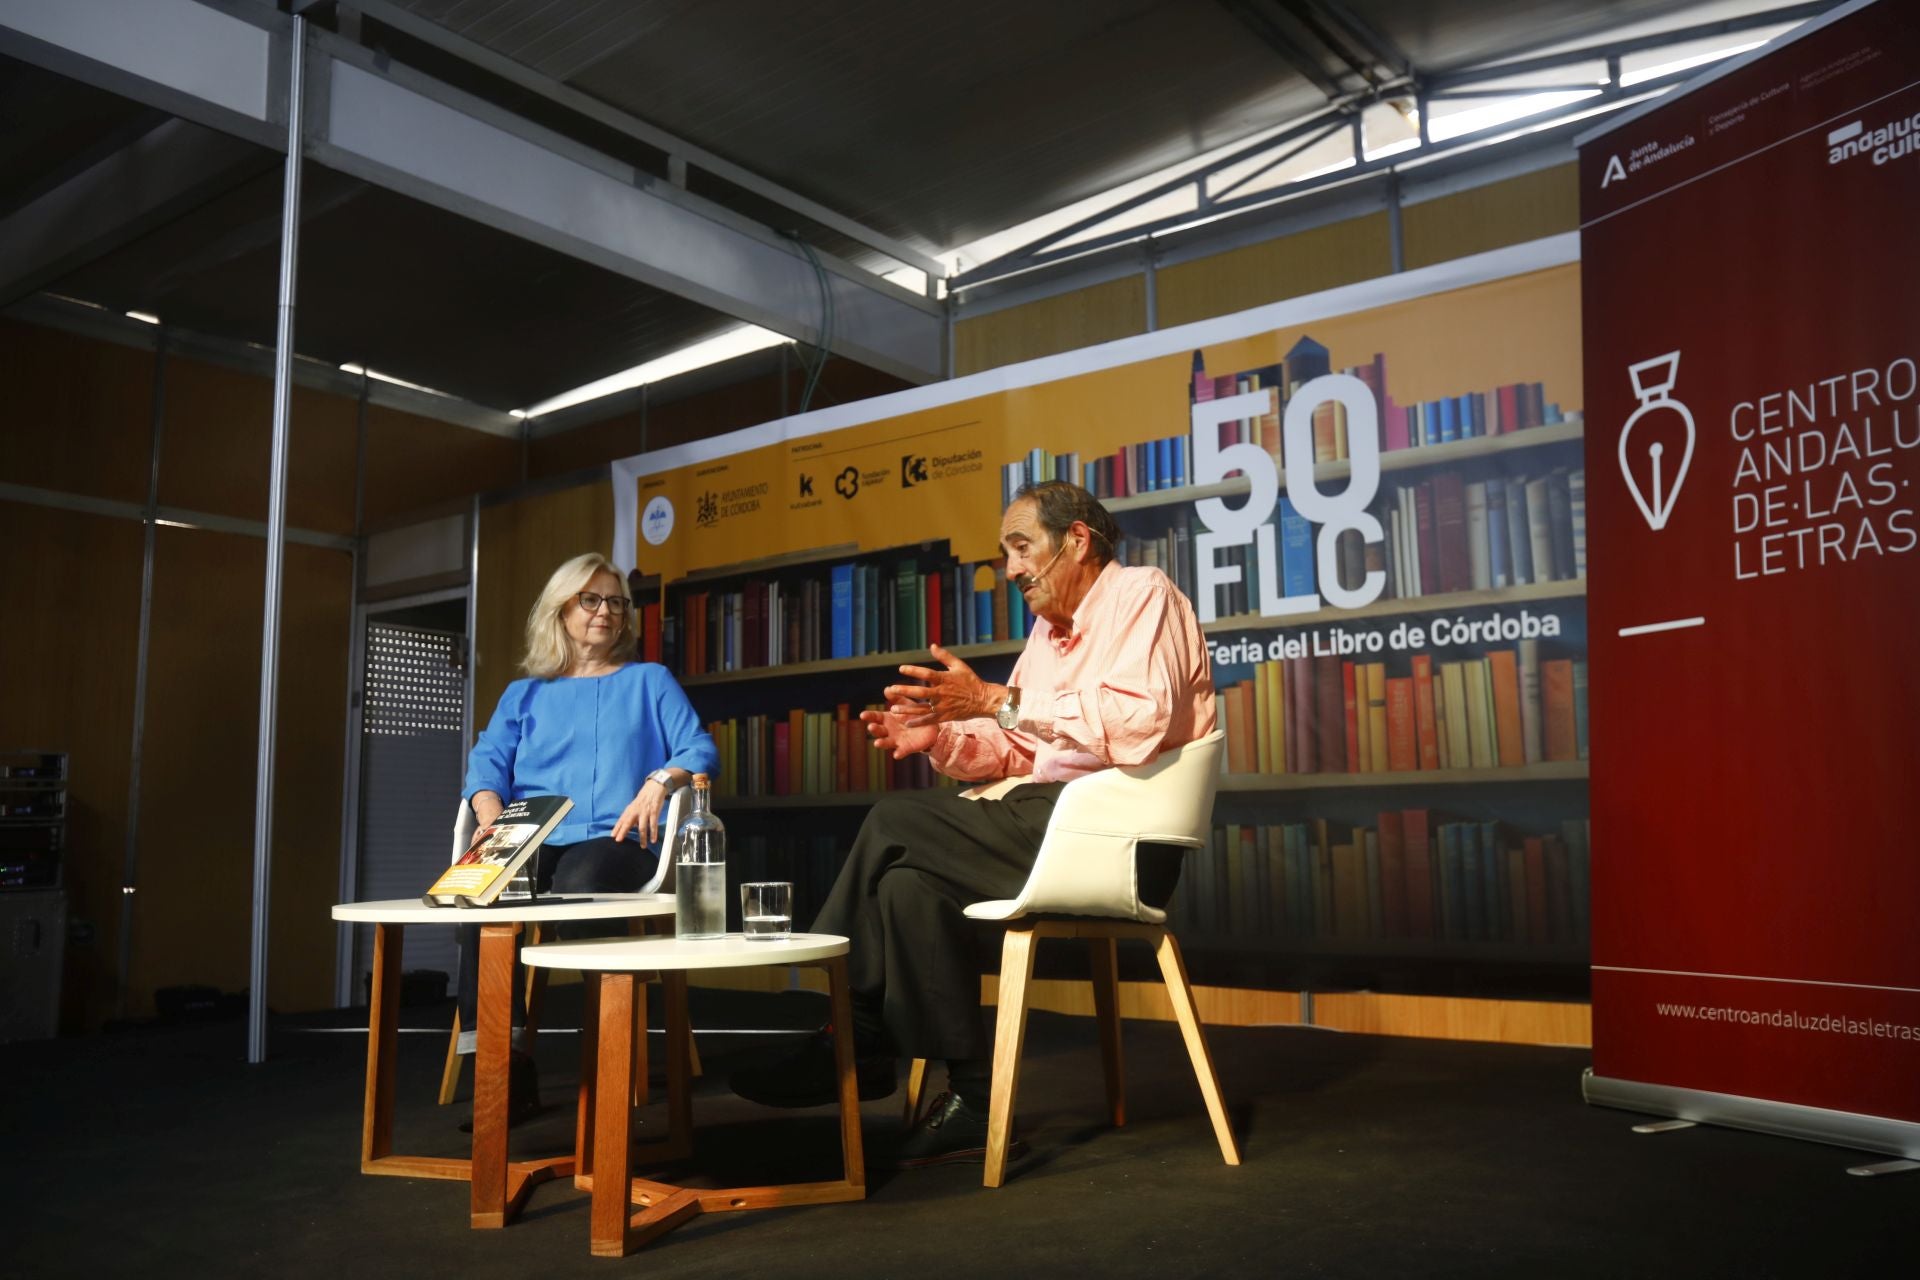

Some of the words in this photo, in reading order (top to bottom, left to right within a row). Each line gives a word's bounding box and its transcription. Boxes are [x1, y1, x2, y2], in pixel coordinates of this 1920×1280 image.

[1759, 82, 1791, 102] Cultura
[1629, 141, 1659, 161] Junta
[1629, 158, 1643, 172] de
[1643, 135, 1696, 168] Andalucía
[1731, 358, 1917, 441] CENTRO
[932, 450, 982, 468] Diputación
[1192, 374, 1380, 536] 50
[1733, 403, 1920, 488] ANDALU
[931, 470, 943, 480] de
[944, 462, 983, 479] Córdoba
[1735, 509, 1917, 580] LETRAS
[1196, 511, 1386, 625] FLC
[1268, 632, 1308, 661] del
[1313, 621, 1384, 658] Libro
[1389, 621, 1425, 650] de
[1431, 611, 1561, 645] Córdoba
[1656, 1003, 1920, 1041] www.centroandaluzdelasletras
